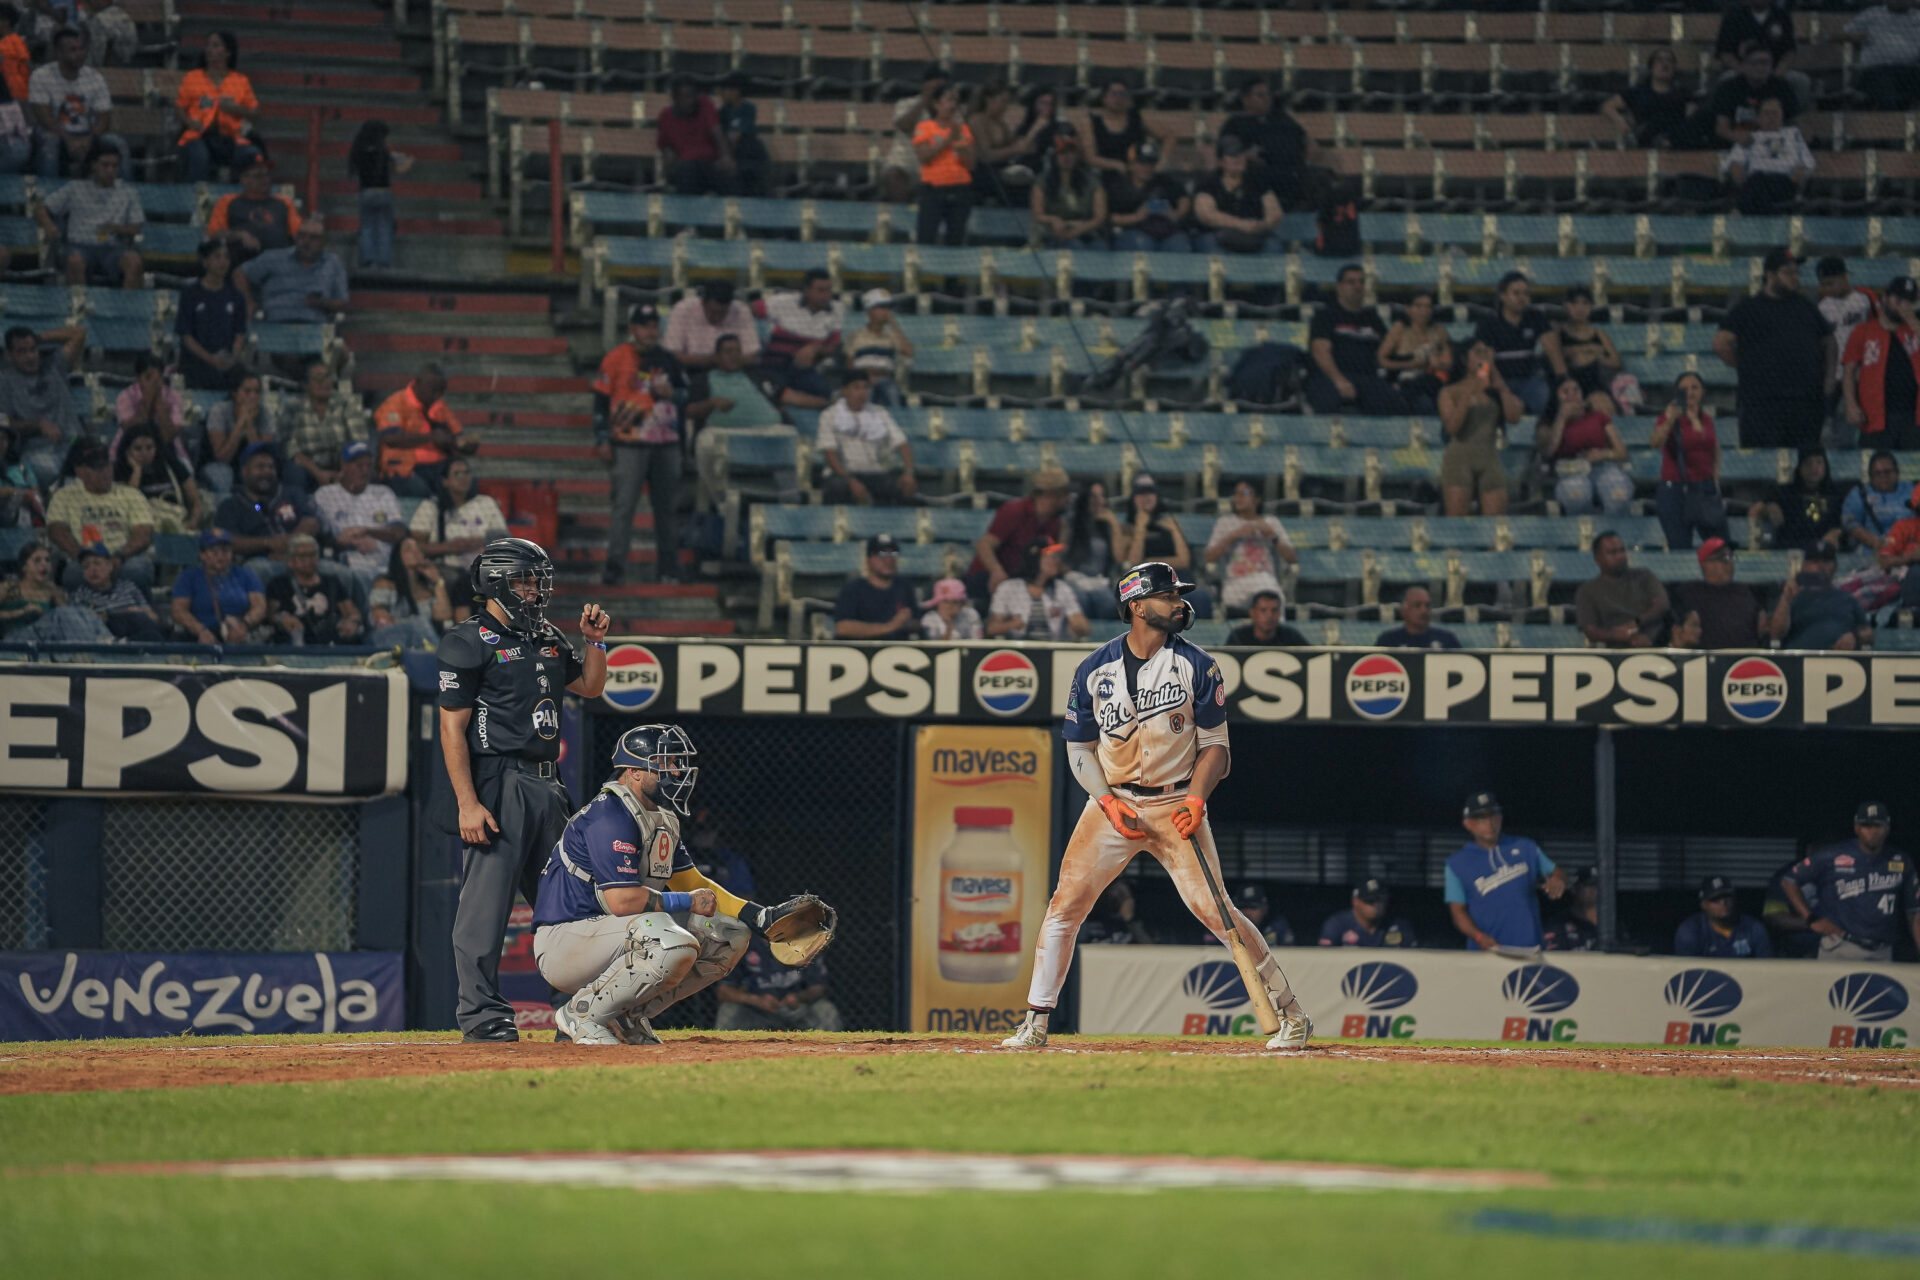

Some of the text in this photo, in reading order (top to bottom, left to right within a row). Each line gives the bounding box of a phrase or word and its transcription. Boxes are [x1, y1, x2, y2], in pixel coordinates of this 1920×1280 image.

[505, 647, 521, 657] BOT
[677, 644, 961, 717] PEPSI
[978, 675, 1033, 689] PEPSI
[1351, 679, 1405, 693] PEPSI
[1424, 653, 1707, 724] PEPSI
[1727, 683, 1783, 697] PEPSI
[1803, 657, 1920, 724] PE
[478, 707, 489, 748] Rexona
[532, 709, 559, 729] PAN
[1100, 702, 1118, 732] La
[0, 675, 347, 792] EPSI
[932, 747, 1038, 775] mavesa
[653, 862, 670, 874] Simple
[951, 876, 1011, 894] mavesa
[1877, 894, 1896, 915] 47
[18, 953, 378, 1033] Venezuela
[1181, 1013, 1257, 1036] BNC
[1340, 1014, 1417, 1038] BNC
[1501, 1017, 1578, 1042] BNC
[1663, 1021, 1741, 1046] BNC
[1828, 1025, 1908, 1049] BNC
